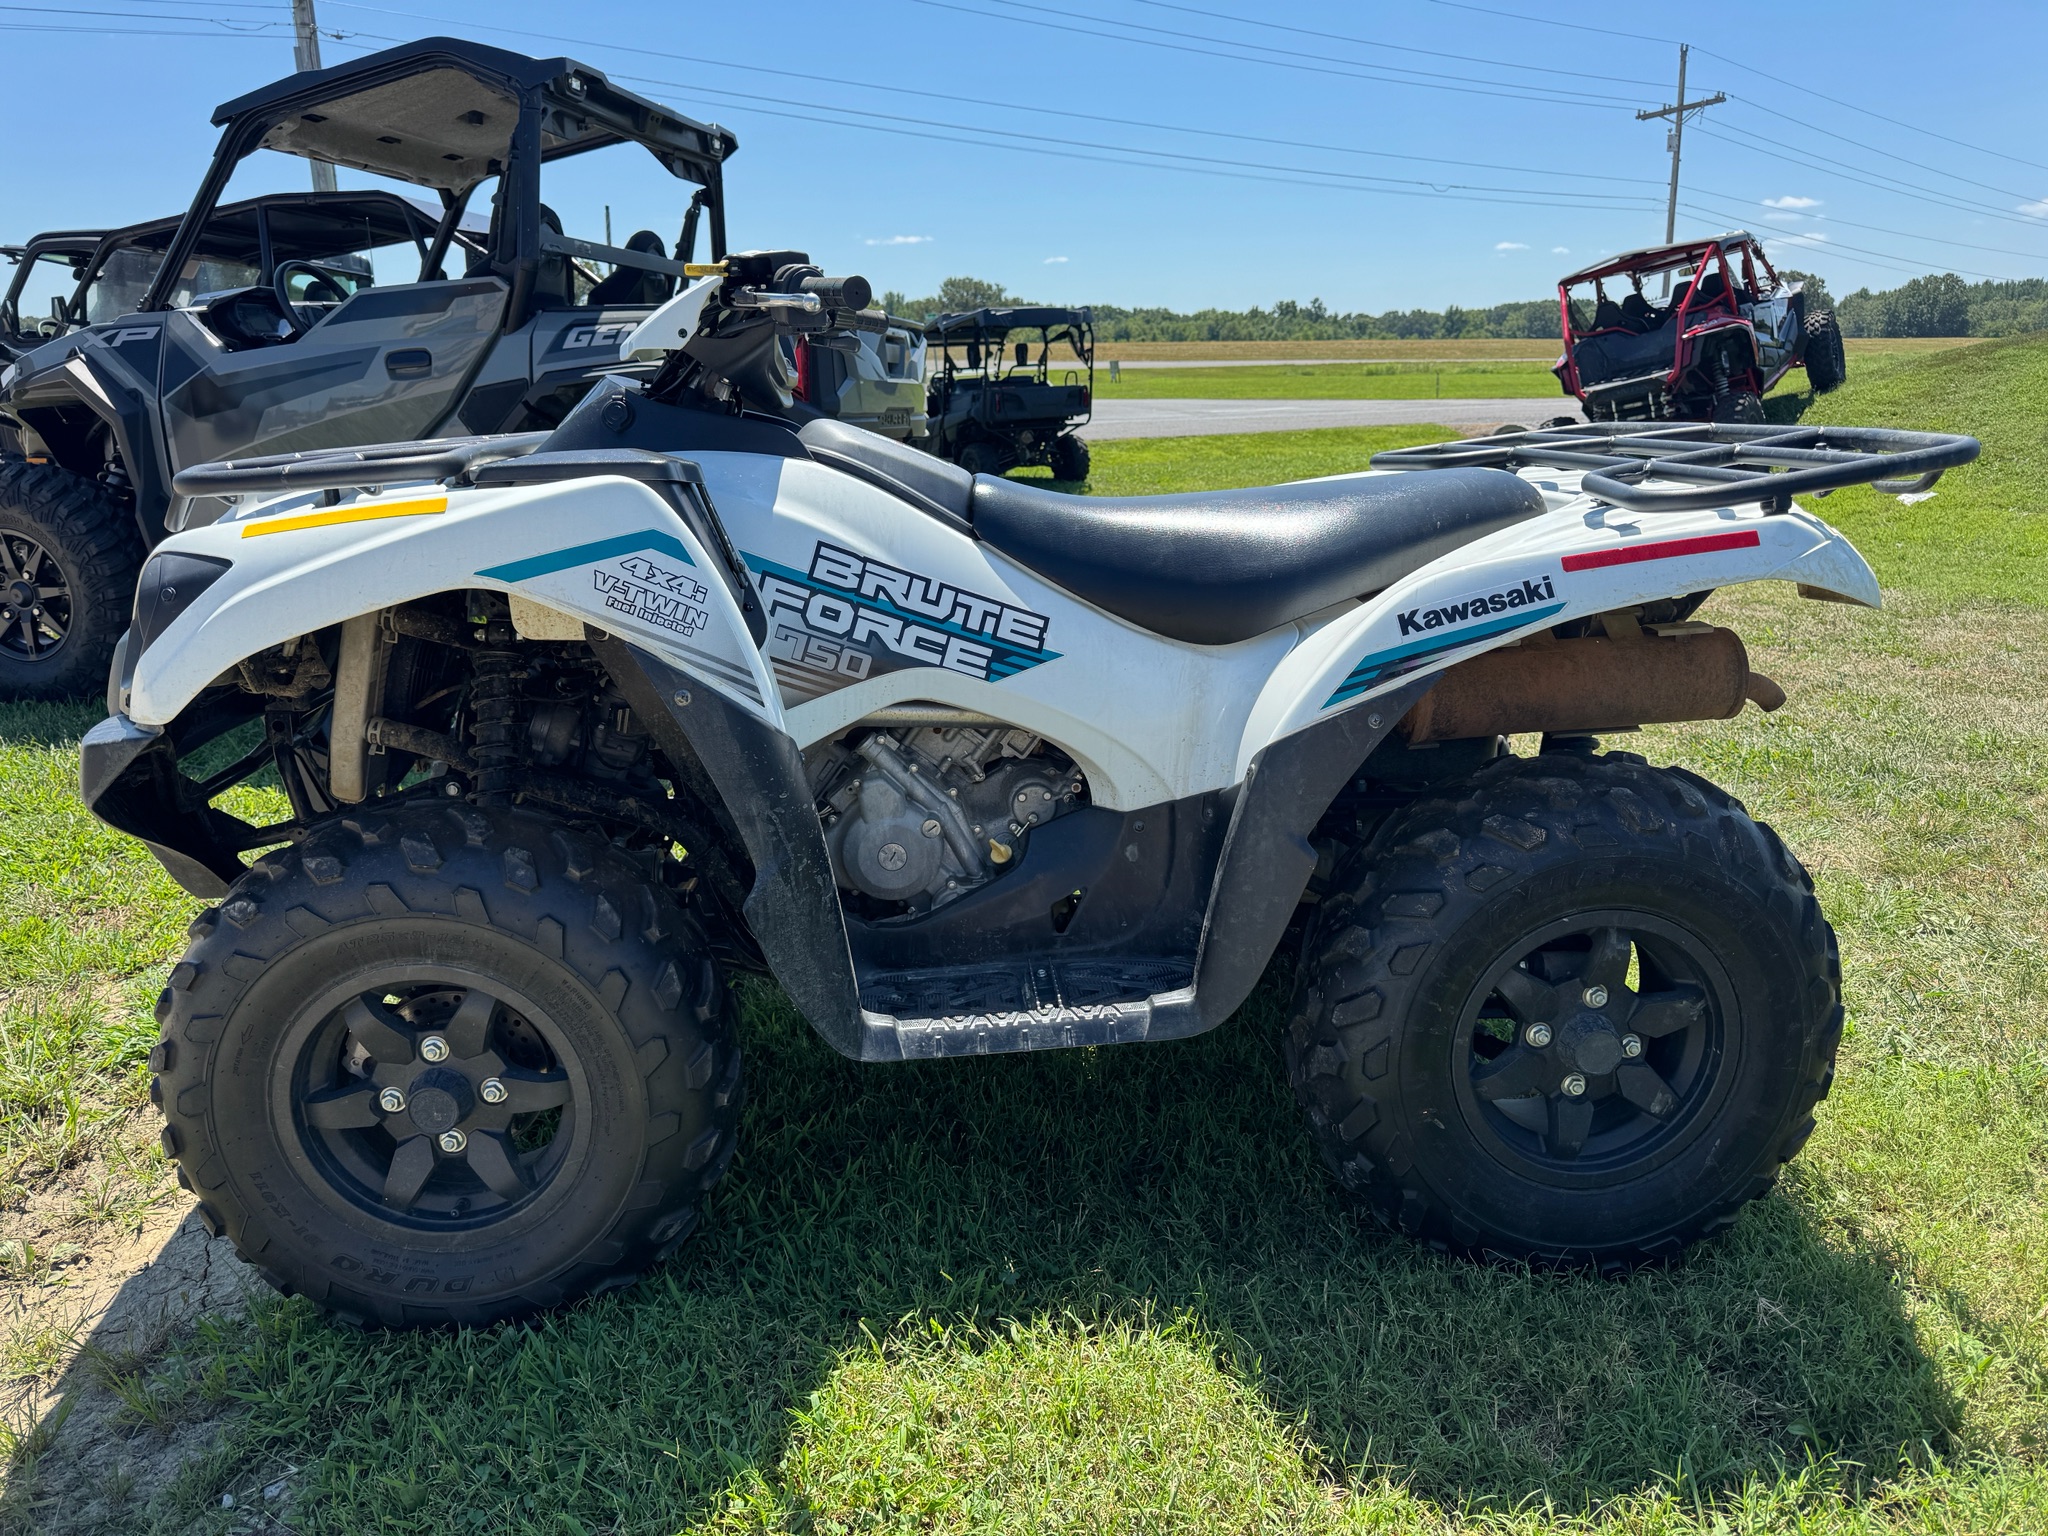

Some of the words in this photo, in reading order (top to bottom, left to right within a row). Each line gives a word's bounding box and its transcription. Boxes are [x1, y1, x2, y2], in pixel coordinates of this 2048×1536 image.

[82, 326, 161, 349] XP
[593, 570, 709, 630] V-TWIN
[606, 596, 636, 615] Fuel
[637, 608, 695, 638] Injected
[760, 571, 993, 681] FORCE
[807, 540, 1050, 654] BRUTE
[1397, 575, 1556, 637] Kawasaki
[774, 623, 873, 681] 750
[561, 978, 593, 1011] WARNING
[330, 1253, 475, 1295] DURO
